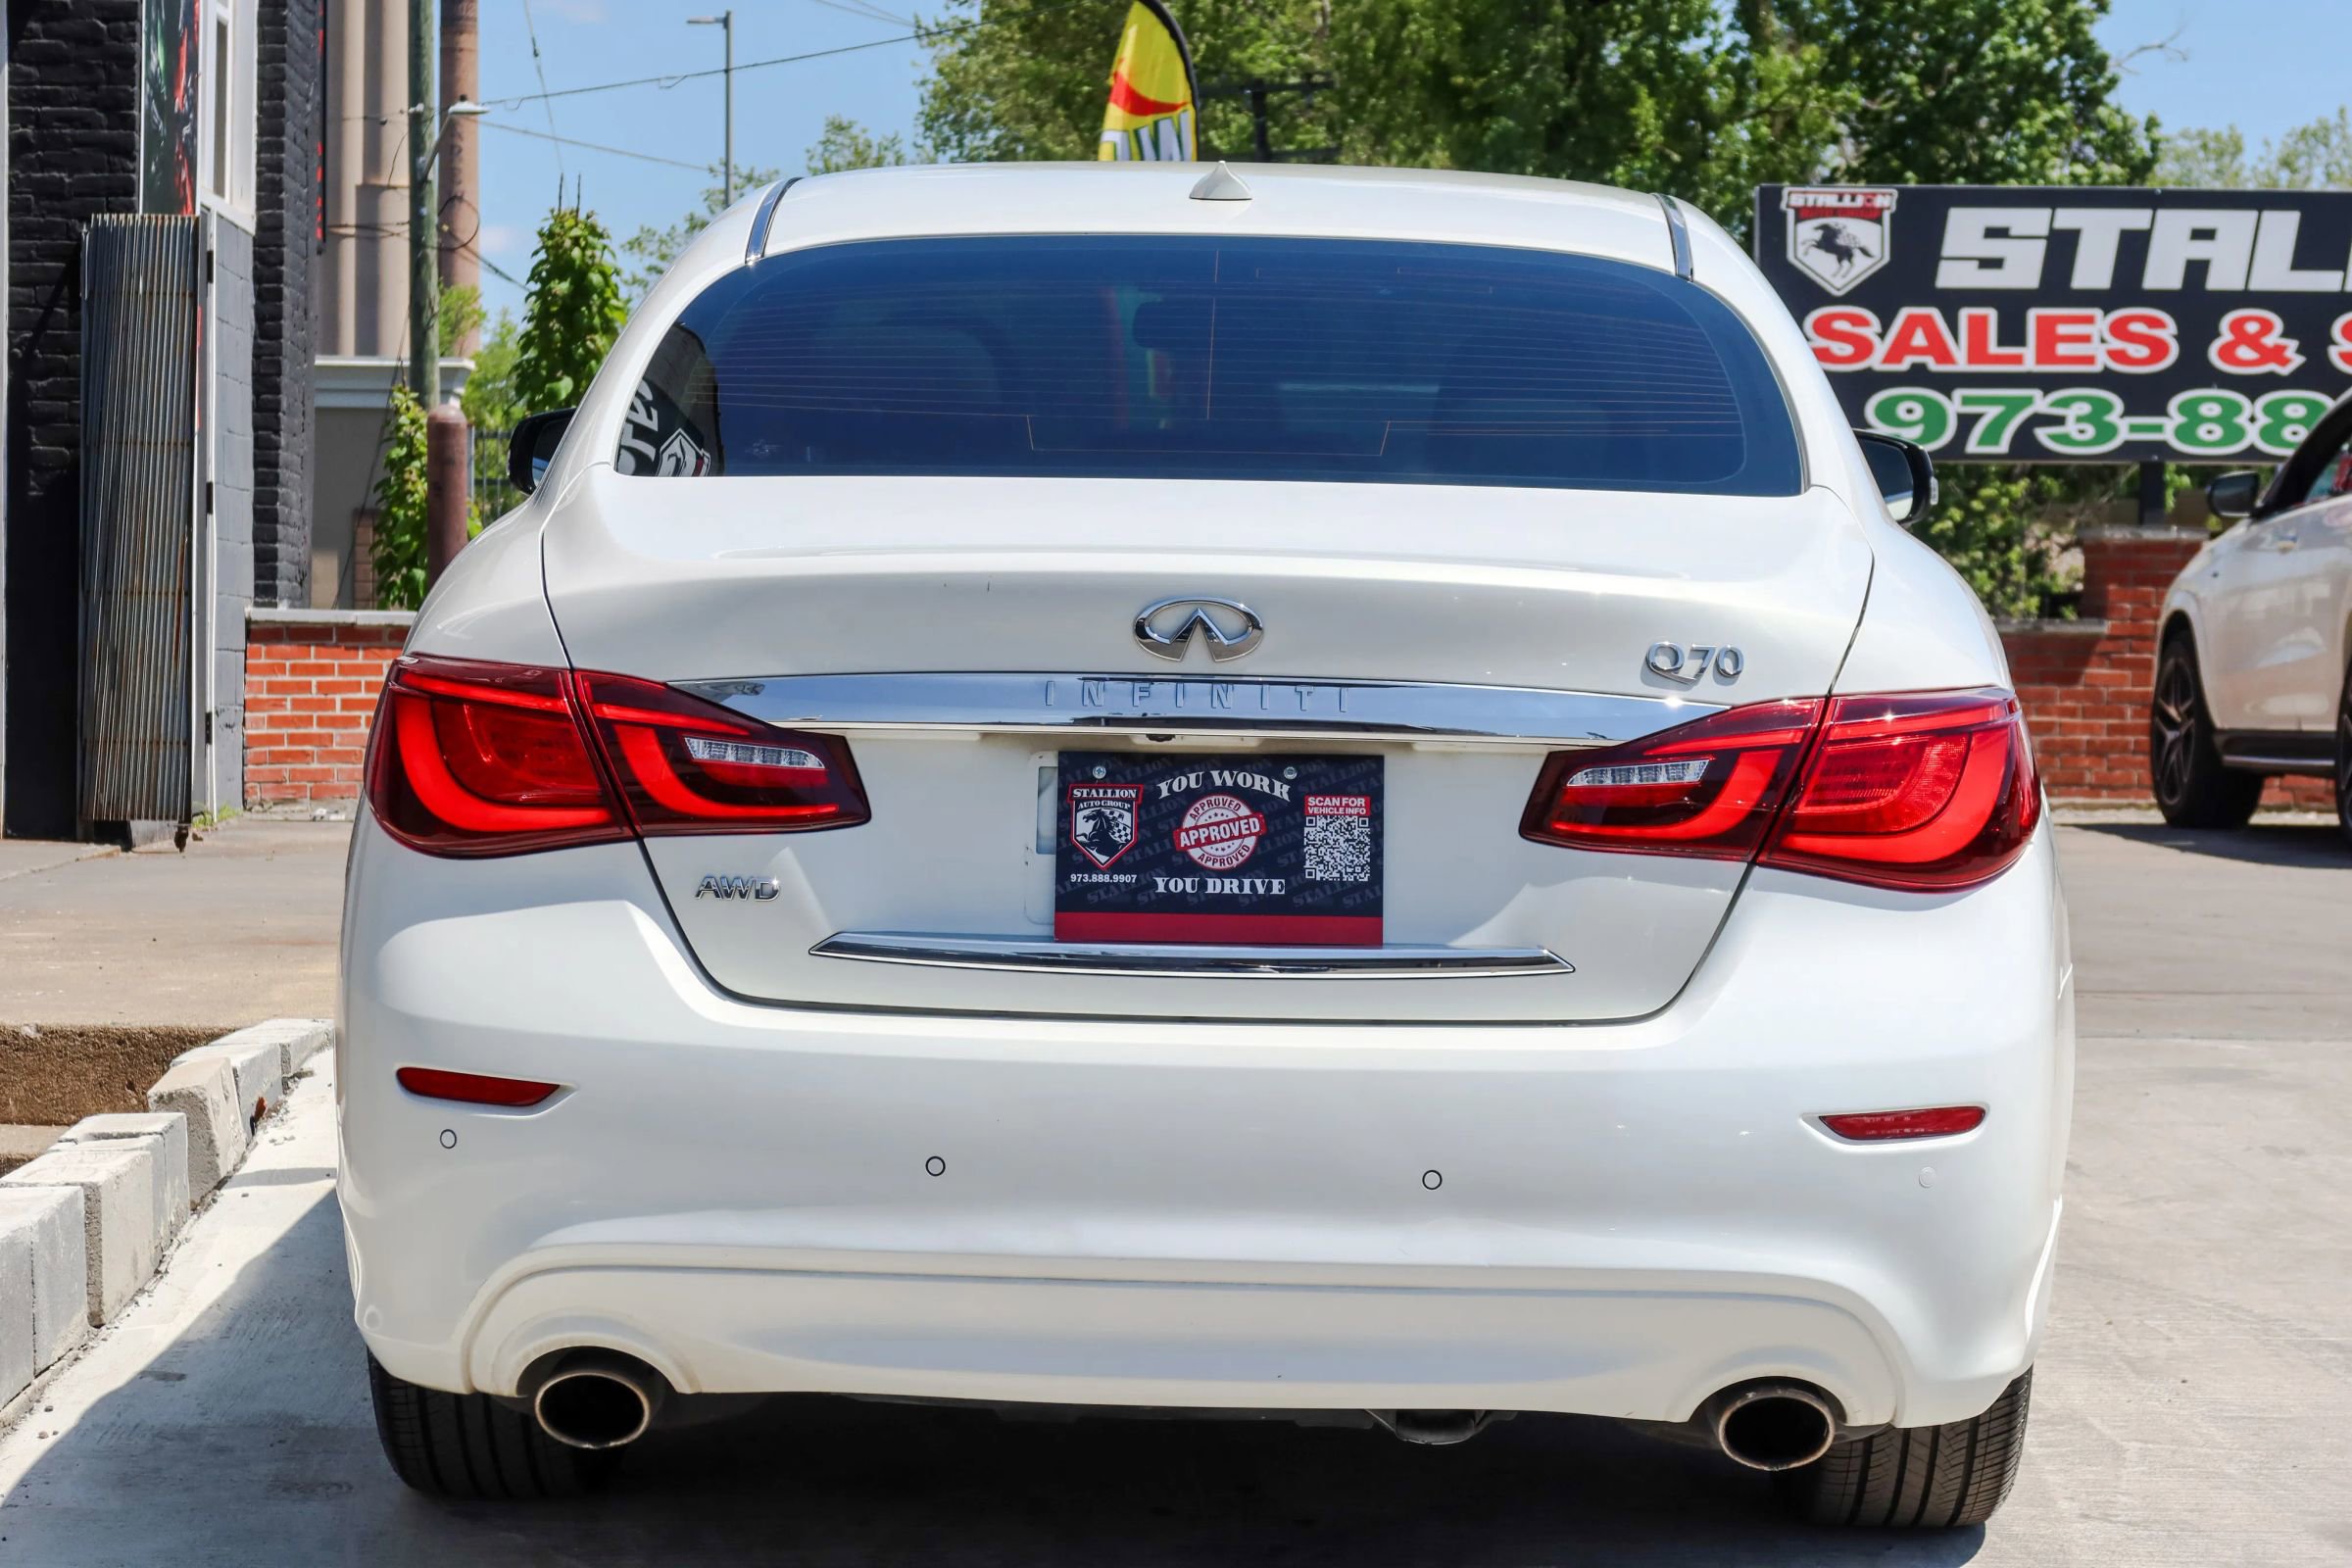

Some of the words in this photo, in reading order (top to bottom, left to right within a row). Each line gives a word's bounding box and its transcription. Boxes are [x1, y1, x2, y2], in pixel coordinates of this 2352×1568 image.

[1934, 208, 2352, 292] STAL
[1803, 305, 2178, 373] SALES
[2208, 307, 2307, 376] &
[1645, 641, 1744, 686] Q70
[1045, 680, 1348, 713] INFINITI
[1072, 788, 1137, 799] STALLION
[1156, 771, 1204, 799] YOU
[1209, 769, 1291, 803] WORK
[1078, 800, 1101, 809] AUTO
[1101, 800, 1131, 809] GROUP
[1189, 797, 1242, 820] APPROVED
[1307, 797, 1341, 807] SCAN
[1342, 797, 1366, 808] FOR
[1346, 807, 1367, 815] INFO
[1179, 817, 1260, 848] APPROVED
[1198, 844, 1250, 867] APPROVED
[695, 875, 782, 902] AWD
[1070, 873, 1138, 883] 973.888.9907
[1152, 877, 1200, 894] YOU
[1204, 877, 1286, 895] DRIVE
